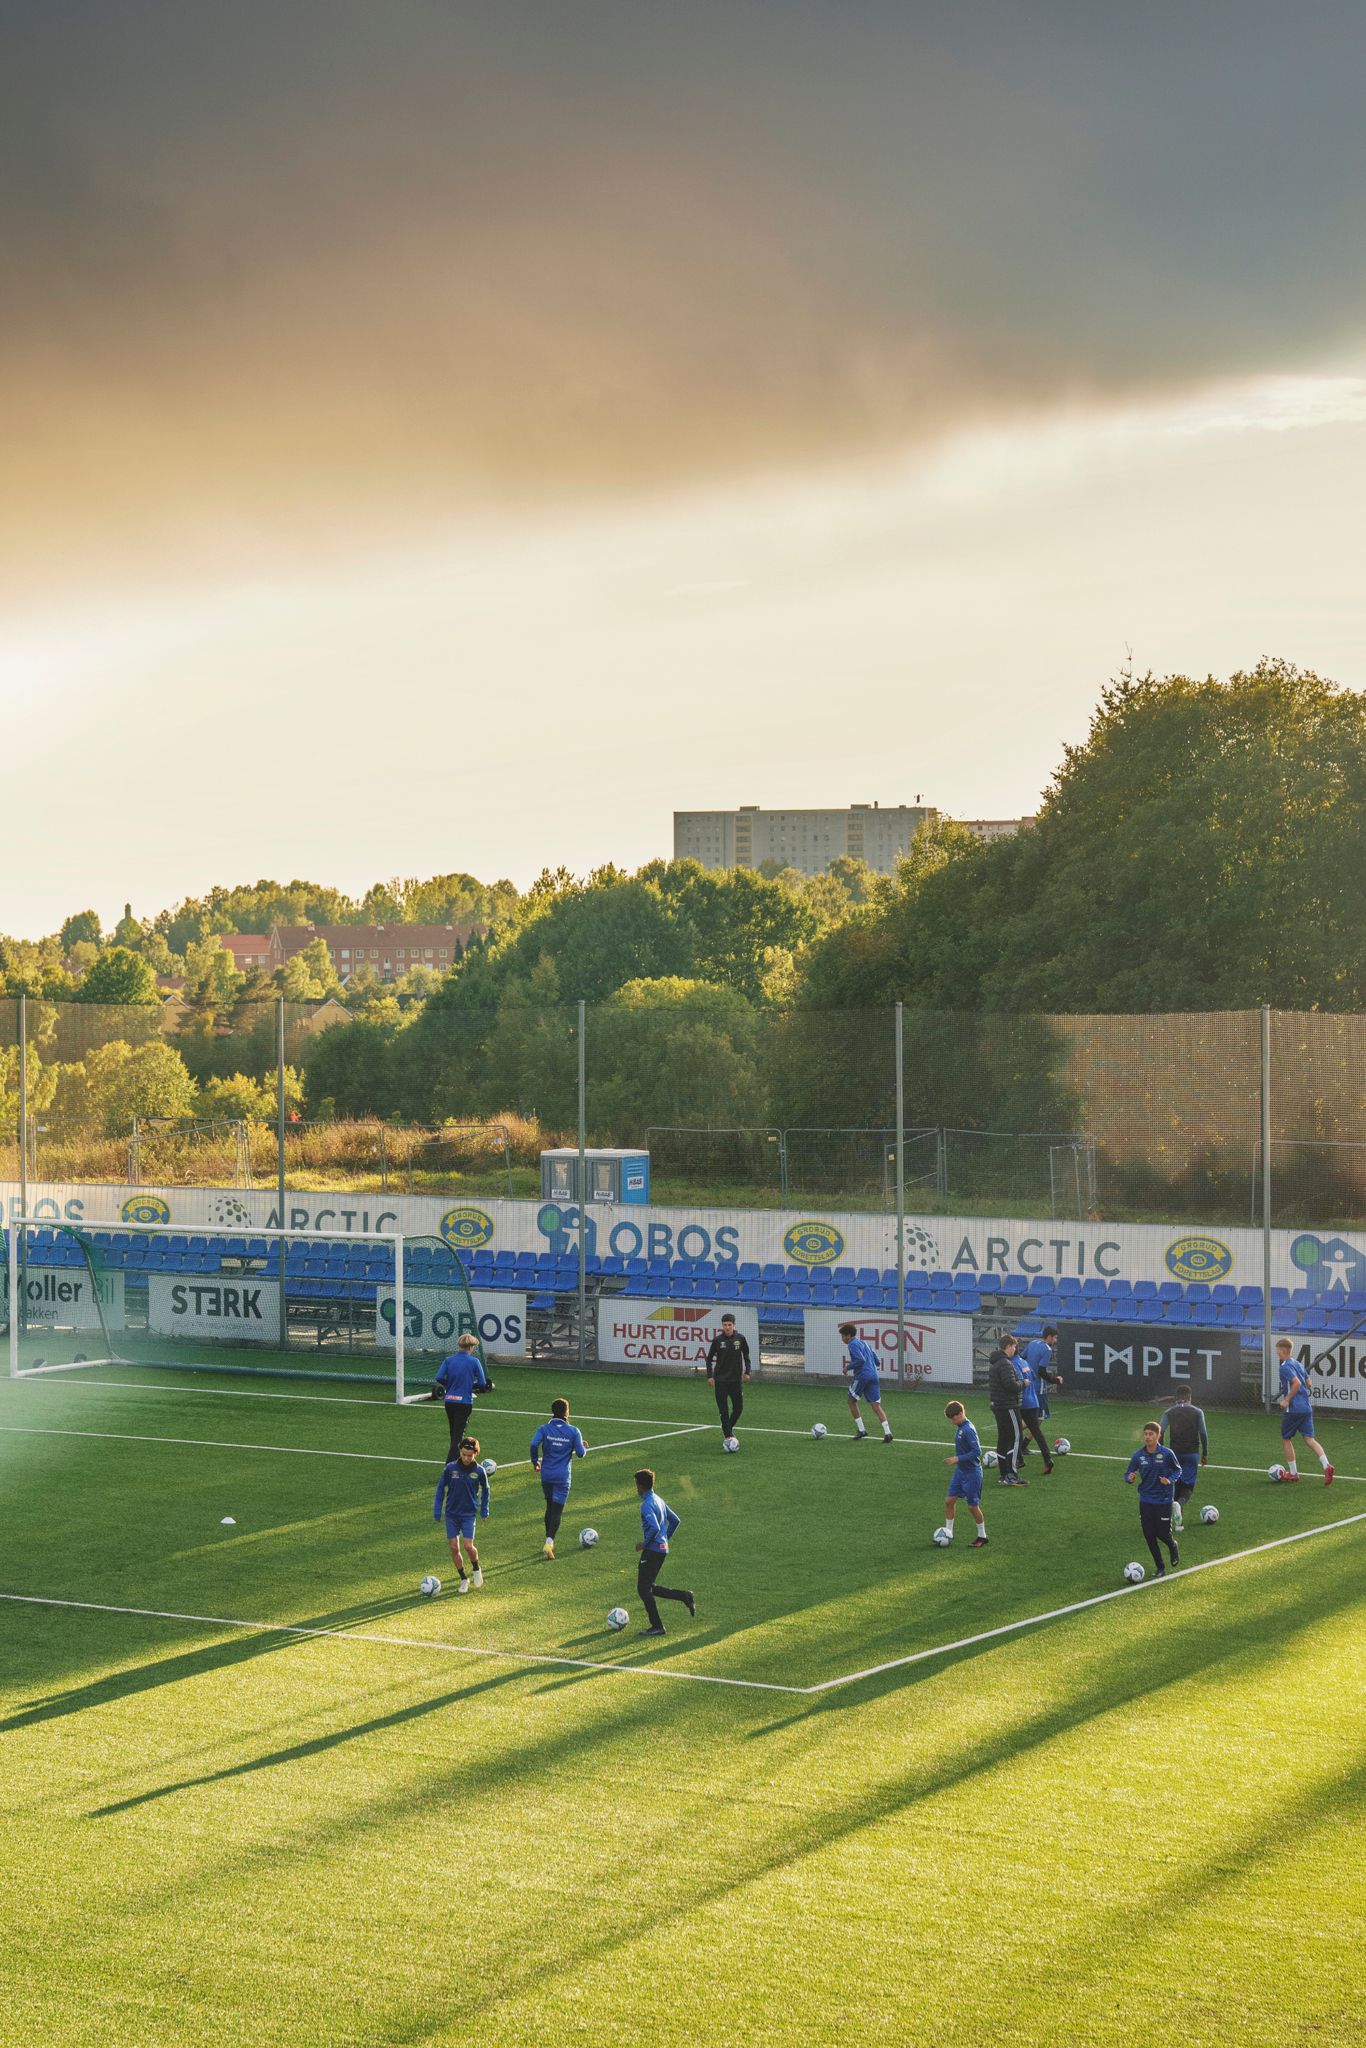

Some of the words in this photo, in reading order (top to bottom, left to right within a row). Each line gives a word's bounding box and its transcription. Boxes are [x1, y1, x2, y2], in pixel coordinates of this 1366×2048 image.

[0, 1196, 84, 1232] BOS
[265, 1207, 398, 1243] ARCTIC
[609, 1221, 740, 1265] OBOS
[797, 1226, 831, 1237] GRORUD
[1180, 1242, 1218, 1252] GRORUD
[951, 1236, 1121, 1277] ARCTIC
[432, 1311, 521, 1344] OBOS
[858, 1327, 923, 1353] HON
[624, 1343, 719, 1363] CARGLA
[890, 1359, 932, 1375] Lnne
[1074, 1342, 1222, 1381] EMPET
